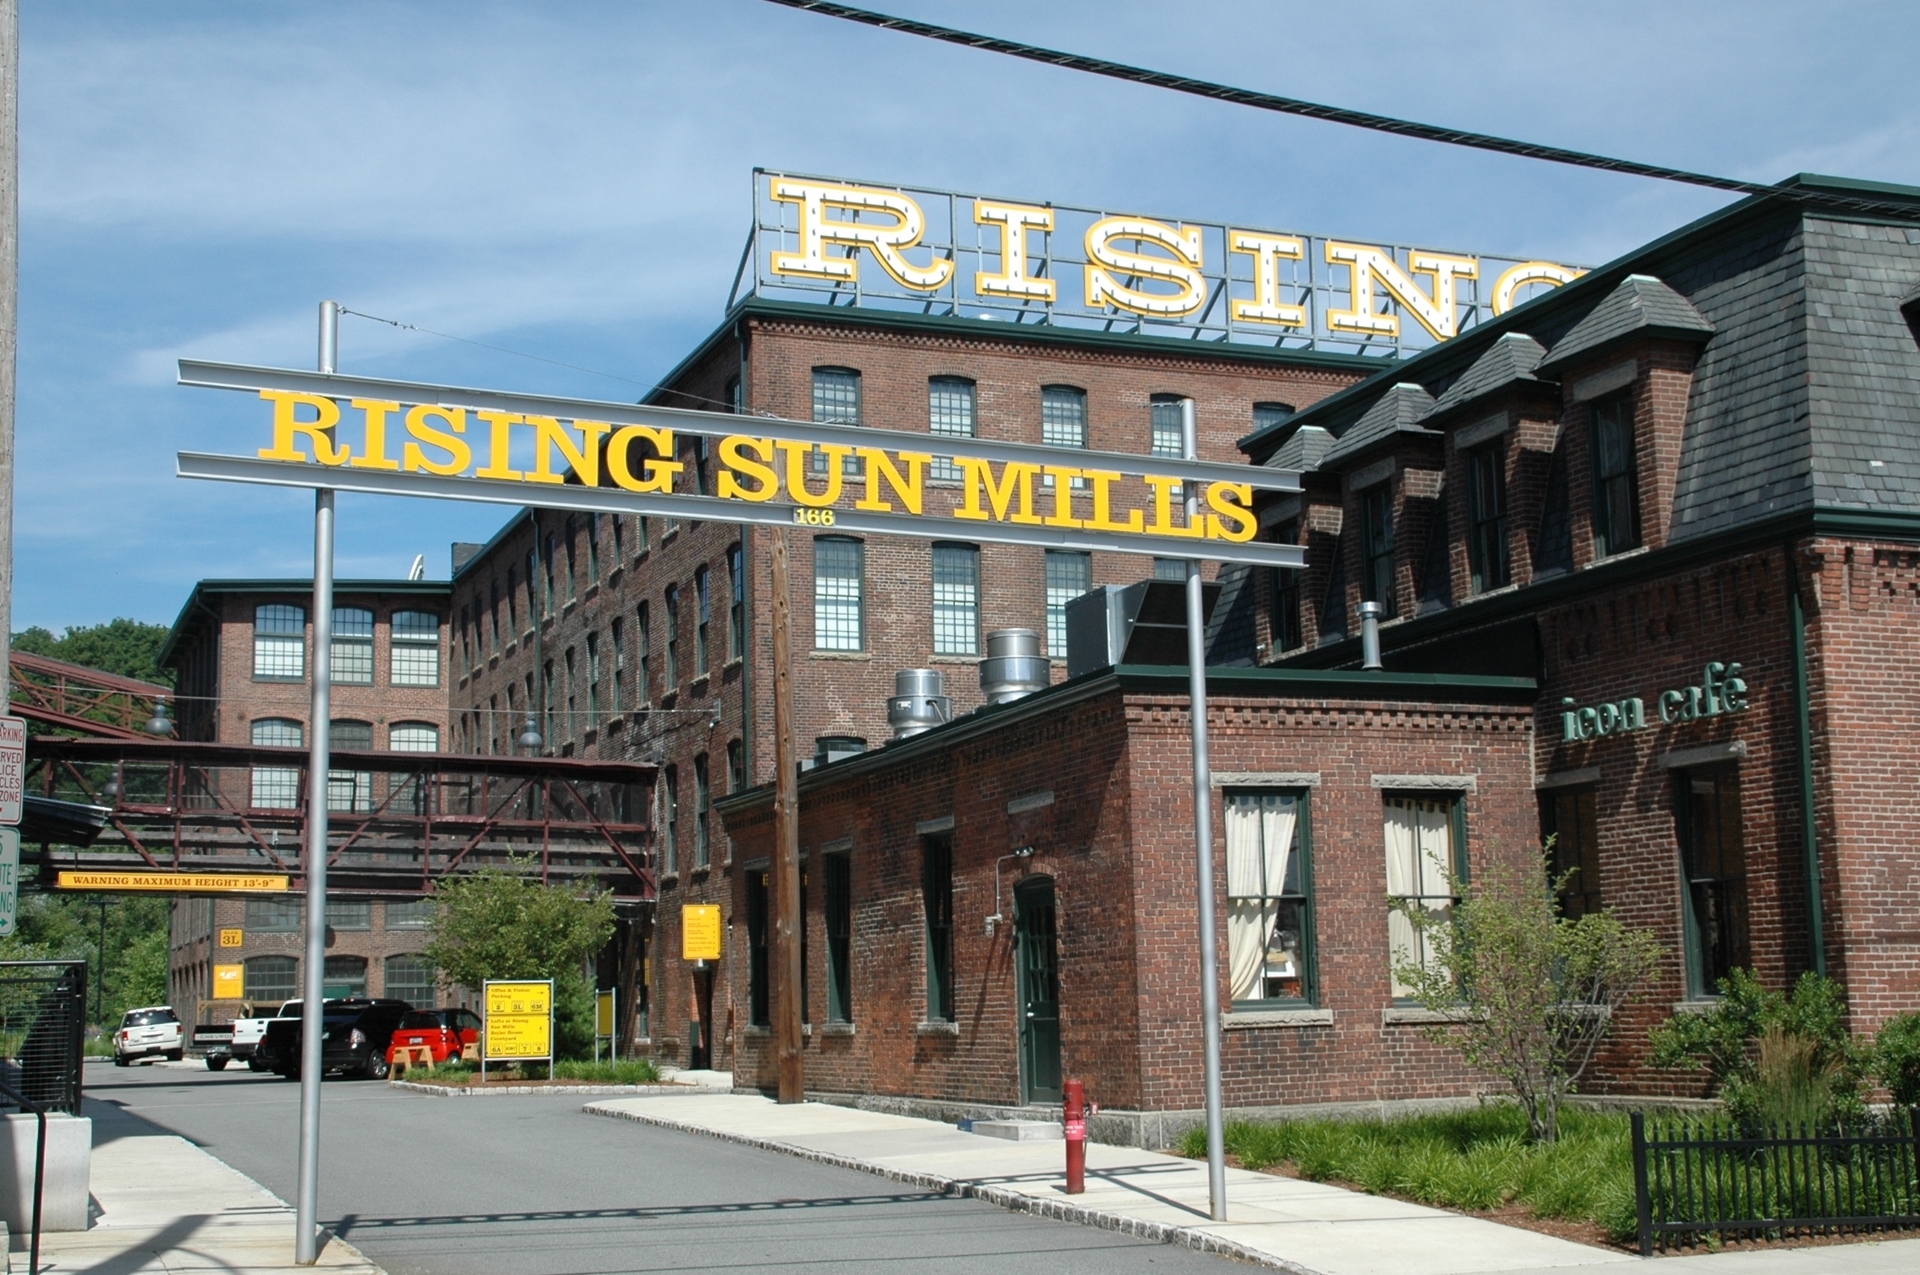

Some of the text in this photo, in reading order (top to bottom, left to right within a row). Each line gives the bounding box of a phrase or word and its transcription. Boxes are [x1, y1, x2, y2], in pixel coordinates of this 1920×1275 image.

[258, 388, 1258, 543] RISING SUN MILLS
[796, 507, 834, 526] 166
[1560, 661, 1749, 743] icon café
[73, 876, 129, 885] WARNING
[133, 877, 191, 886] MAXIMUM
[195, 878, 239, 887] HEIGHT
[222, 935, 240, 945] 3L
